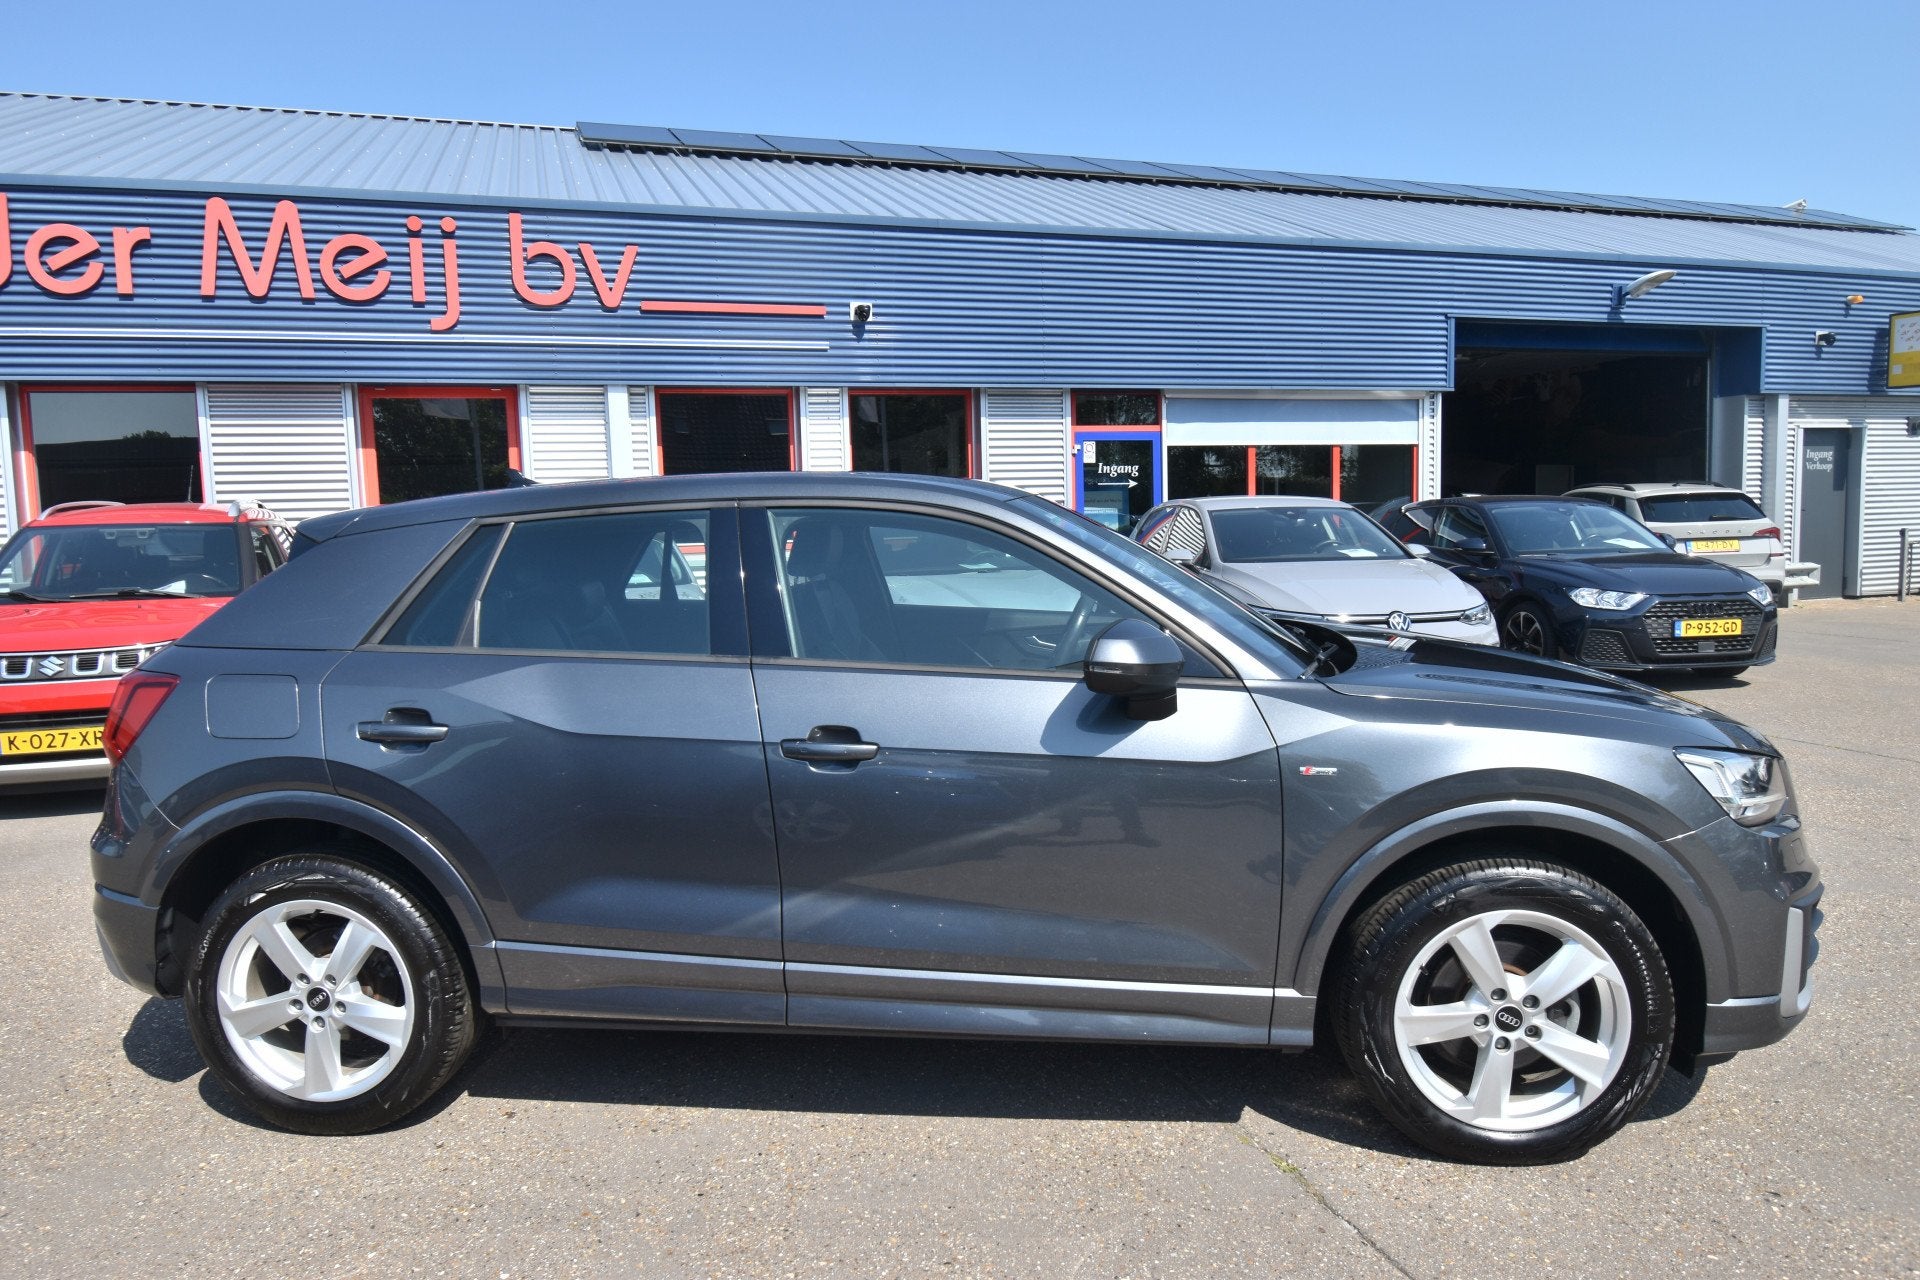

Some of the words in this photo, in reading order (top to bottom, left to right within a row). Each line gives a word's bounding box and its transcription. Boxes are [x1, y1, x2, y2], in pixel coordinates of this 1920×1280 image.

[0, 192, 150, 294] er
[201, 197, 460, 330] Meij
[509, 213, 638, 308] bv
[1806, 449, 1833, 461] Ingang
[1098, 463, 1138, 477] Ingang
[1685, 622, 1738, 634] P-952-GD
